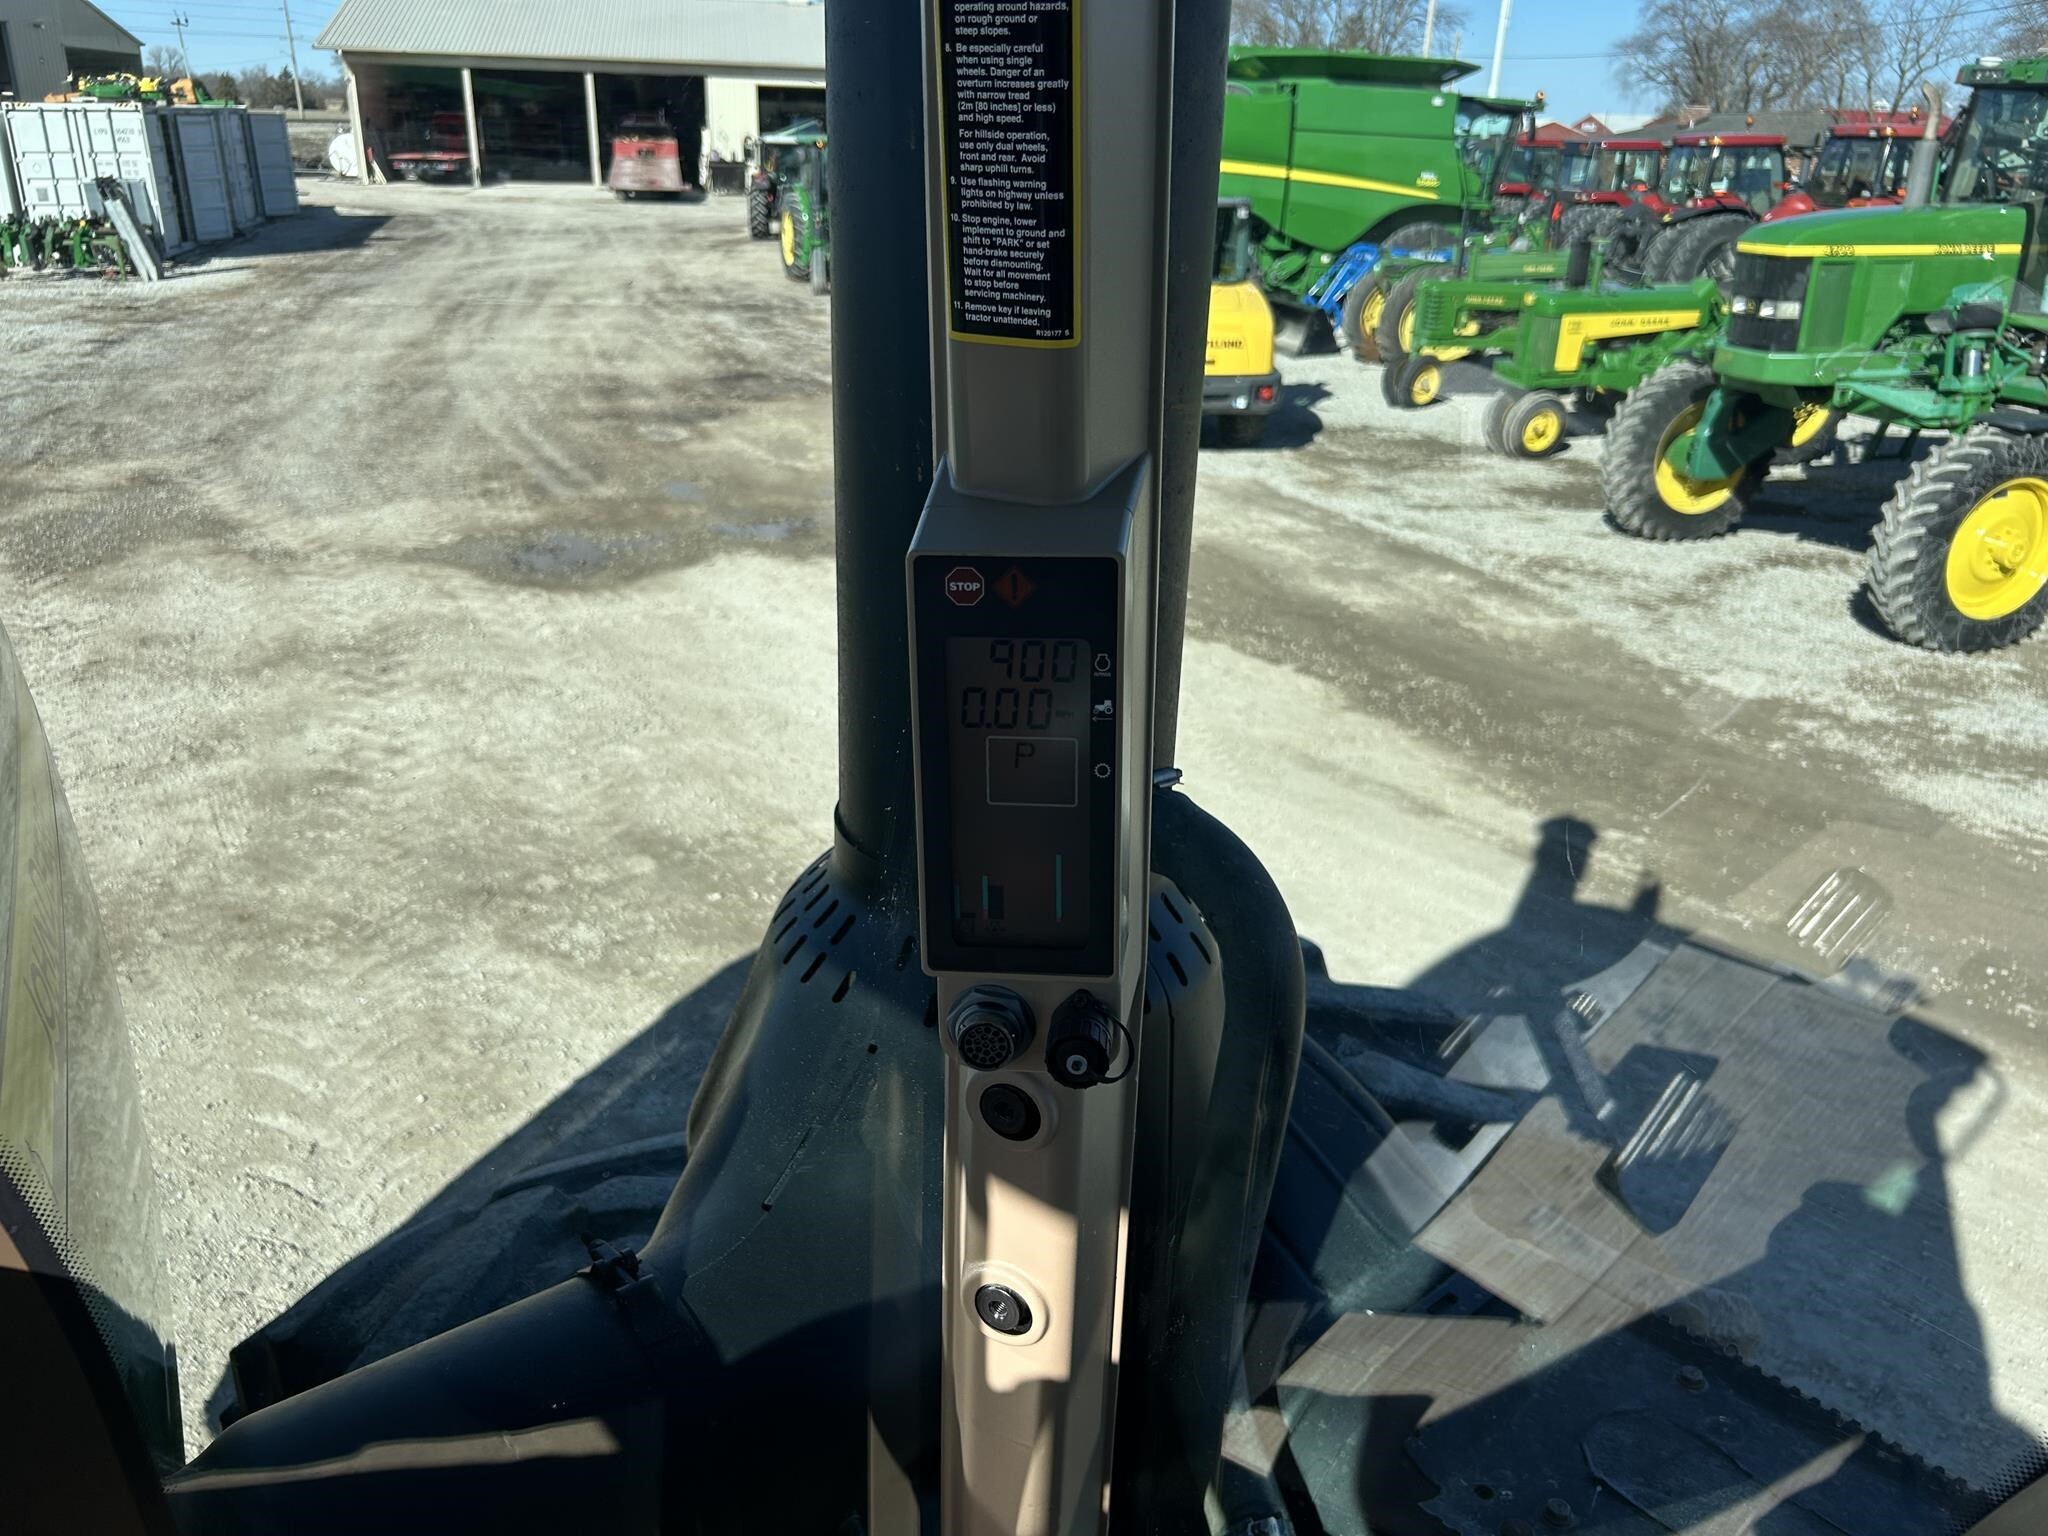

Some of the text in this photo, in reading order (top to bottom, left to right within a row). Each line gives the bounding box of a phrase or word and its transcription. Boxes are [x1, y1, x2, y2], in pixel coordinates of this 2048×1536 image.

[955, 3, 994, 13] operating
[997, 3, 1027, 11] around
[955, 14, 1037, 24] on rough ground or
[955, 27, 1011, 37] steep slopes.
[956, 44, 967, 52] Be
[969, 44, 1011, 55] especially
[1013, 44, 1043, 52] careful
[956, 56, 1032, 67] when using single
[957, 68, 988, 76] wheels.
[990, 68, 1020, 78] Danger
[1023, 68, 1032, 76] of
[958, 80, 1069, 90] overturn increases greatly
[958, 91, 974, 99] with
[1008, 92, 1030, 100] tread
[958, 102, 973, 111] (2m
[976, 102, 988, 112] [80
[990, 102, 1021, 113] inches]
[1035, 103, 1056, 113] less)
[959, 114, 1024, 124] and high speed.
[959, 129, 1050, 141] For hillside operation,
[976, 142, 994, 152] only
[996, 142, 1013, 150] dual
[1016, 143, 1048, 152] wheels,
[960, 152, 979, 160] front
[981, 152, 996, 161] and
[1021, 154, 1046, 162] Avoid
[960, 163, 1034, 174] sharp uphill turns.
[951, 177, 1047, 190] 9. Use flashing warning
[961, 189, 983, 198] lights
[998, 190, 1032, 200] highway
[962, 200, 1032, 211] prohibited by law.
[951, 214, 1037, 226] 10. Stop engine, lower
[963, 225, 1065, 239] implement to ground and
[963, 236, 981, 244] shift
[982, 237, 991, 245] to
[993, 238, 1023, 247] "PARK"
[1037, 240, 1050, 248] set
[963, 247, 1044, 261] hand-brake securely
[963, 257, 1043, 271] before dismounting.
[964, 267, 1050, 280] Wait for all movement
[964, 278, 1019, 289] to stop before
[965, 289, 1046, 303] servicing machinery.
[954, 301, 963, 310] 11.
[965, 302, 996, 312] Remove
[999, 304, 1012, 315] key
[1022, 307, 1051, 318] leaving
[966, 313, 1040, 326] tractor unattended.
[949, 582, 981, 591] STOP
[990, 640, 1078, 683] 900
[961, 687, 1053, 729] 0.00
[1014, 742, 1035, 768] P
